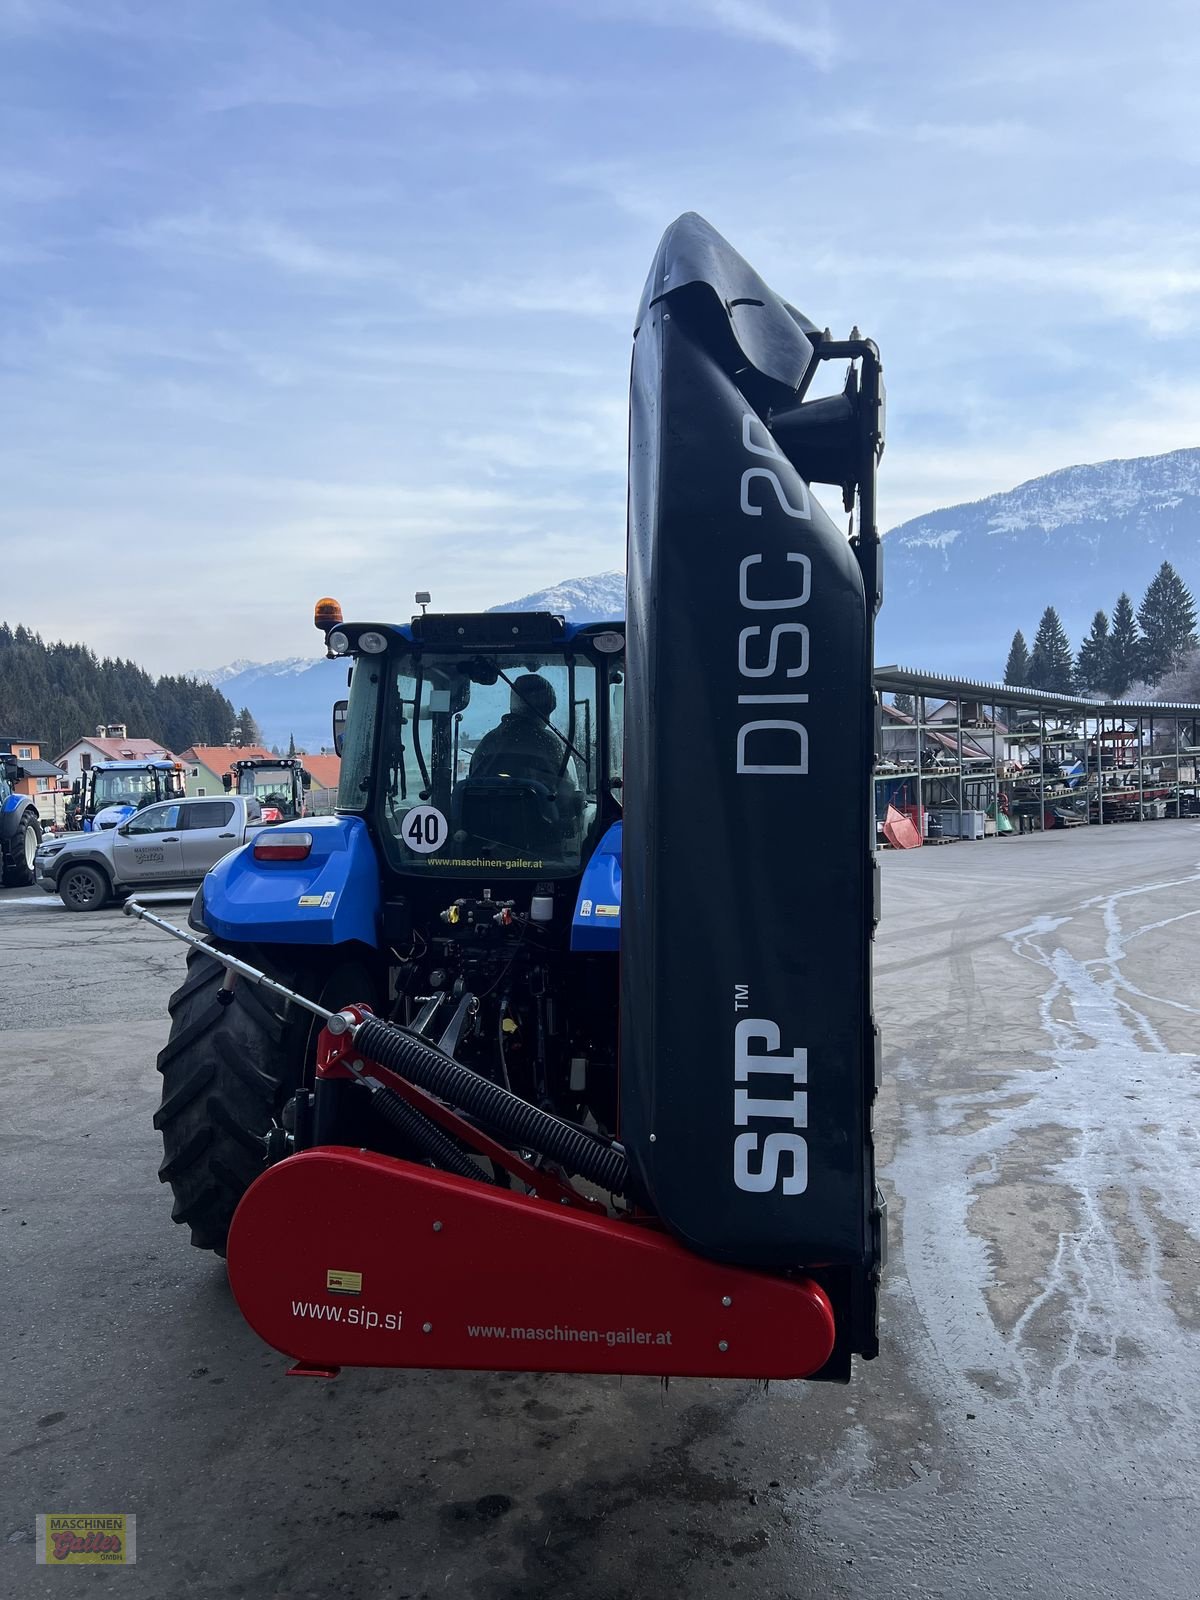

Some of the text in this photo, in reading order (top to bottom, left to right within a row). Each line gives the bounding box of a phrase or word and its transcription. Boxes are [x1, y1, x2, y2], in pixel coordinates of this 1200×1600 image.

[736, 552, 812, 775] DISC
[408, 814, 439, 845] 40
[427, 857, 543, 870] www.maschinen-gailer.at
[734, 984, 808, 1196] SIP TM
[292, 1300, 403, 1331] www.sip.si
[467, 1325, 673, 1347] www.maschinen-gailer.at
